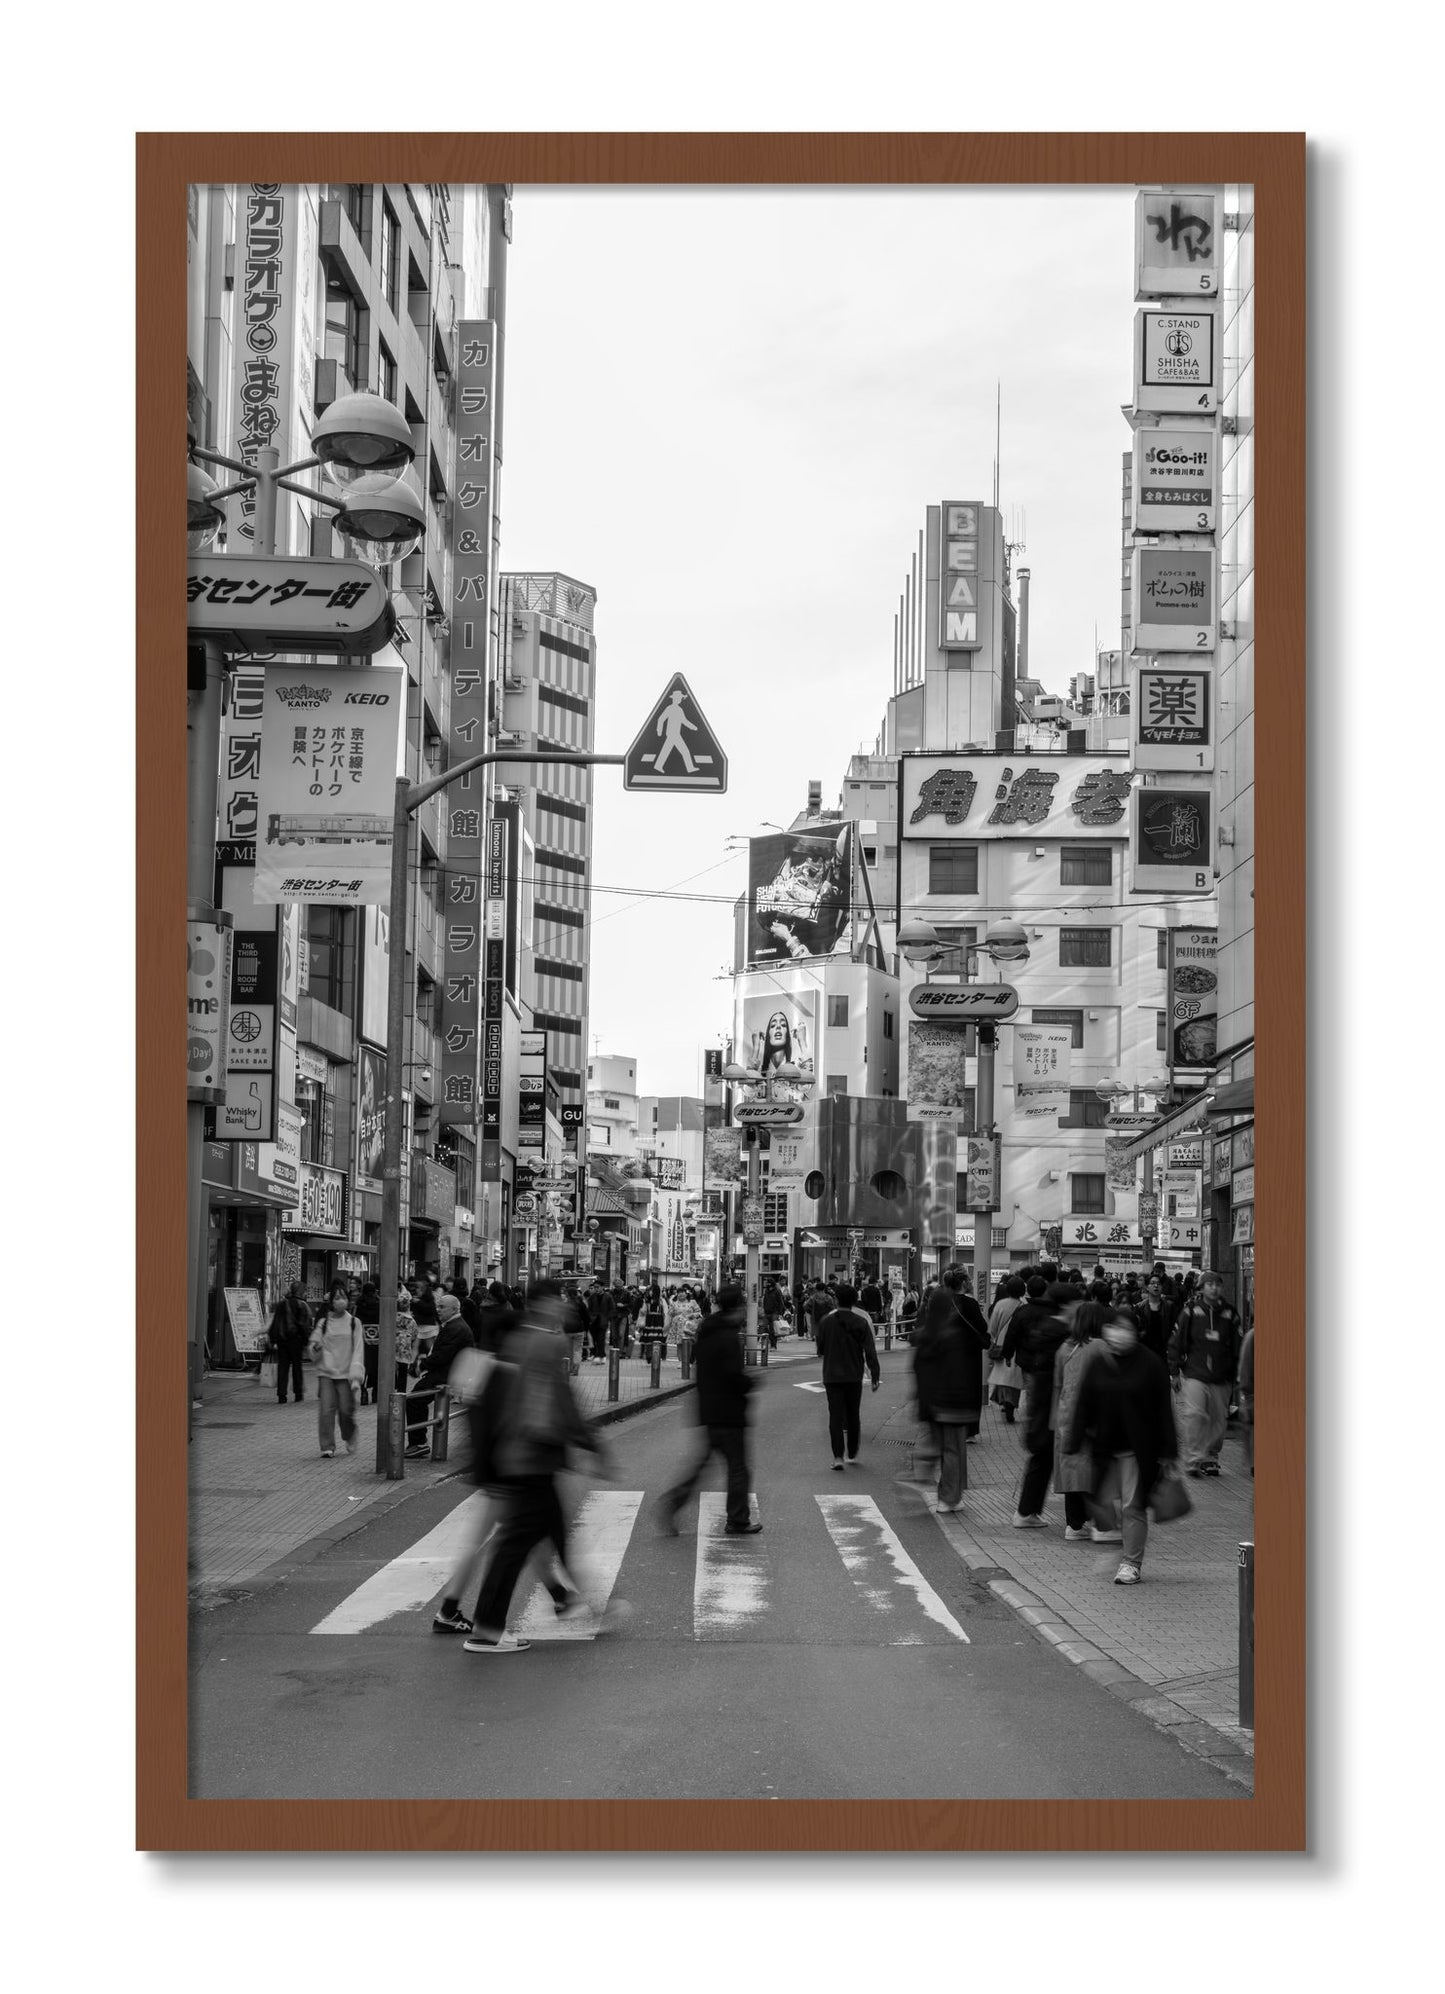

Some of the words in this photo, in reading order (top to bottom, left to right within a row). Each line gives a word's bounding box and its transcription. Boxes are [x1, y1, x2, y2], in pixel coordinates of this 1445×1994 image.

[244, 195, 284, 324] カラオケ
[1200, 275, 1211, 290] 5
[1157, 319, 1201, 330] C.STAND
[1157, 357, 1200, 369] SHISHA
[1157, 368, 1200, 377] CAFE&BAR
[1156, 449, 1207, 464] Goo-it!
[1145, 491, 1208, 503] 全身もみほぐし
[1197, 513, 1208, 529] 3
[947, 506, 979, 641] BEAM
[1196, 632, 1208, 647] 2
[287, 700, 321, 709] KANTO
[344, 692, 391, 707] KEIO
[1149, 677, 1197, 726] 薬
[292, 725, 308, 767] 冒険へ
[309, 726, 327, 797] カントーの
[327, 726, 346, 797] ポケパーク
[347, 727, 366, 784] 京王線で
[1196, 752, 1204, 767] 1
[910, 766, 1135, 826] 角海老
[492, 823, 502, 857] kimono
[280, 878, 365, 892] 渋谷センター街
[491, 861, 502, 894] hearts
[1195, 873, 1206, 888] B
[237, 949, 259, 957] THIRD
[241, 942, 255, 950] THE
[444, 876, 478, 1104] カラオケ館
[916, 991, 1013, 1005] 渋谷センター街
[1174, 1000, 1201, 1020] 6F
[193, 1045, 212, 1059] Day!
[230, 1058, 250, 1066] SAKE
[252, 1058, 268, 1066] BAR
[226, 1106, 258, 1118] Whisky
[563, 1110, 583, 1121] GU
[225, 1116, 246, 1125] Bank
[1075, 1222, 1131, 1242] 兆楽
[674, 1220, 683, 1260] BEER
